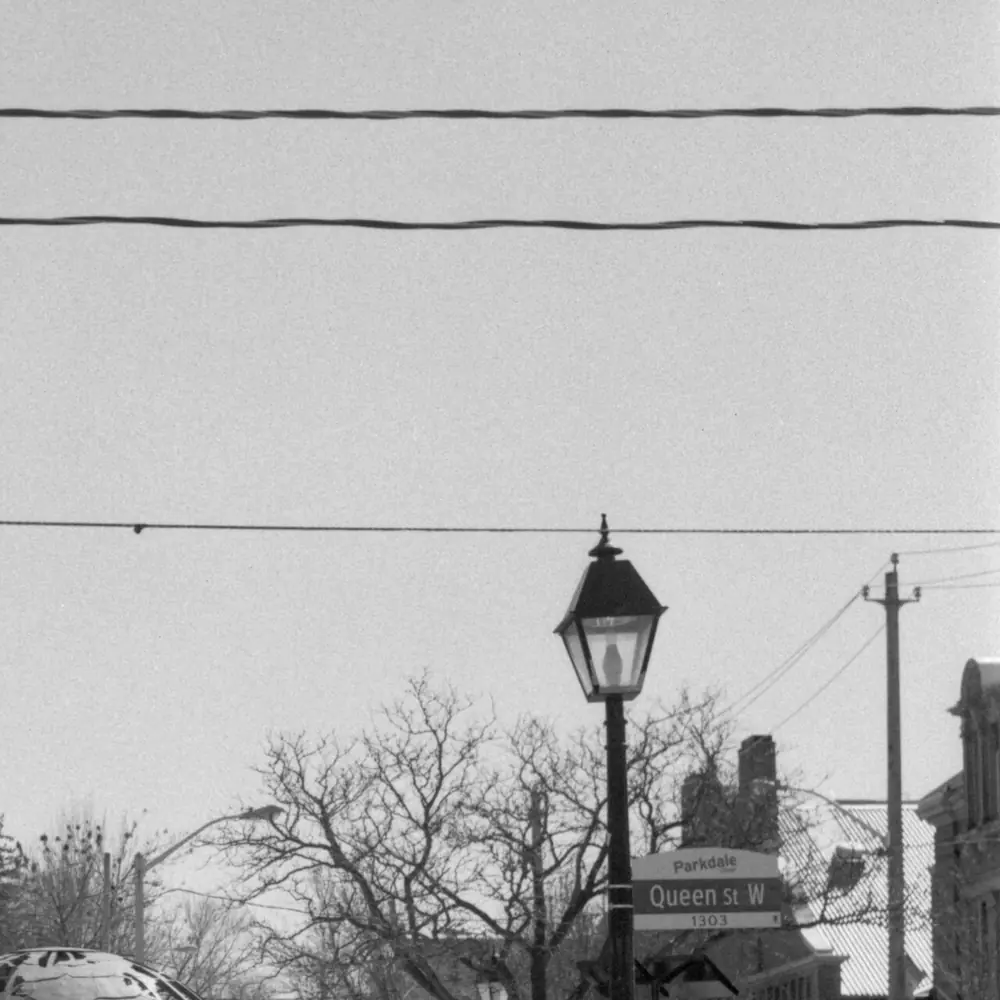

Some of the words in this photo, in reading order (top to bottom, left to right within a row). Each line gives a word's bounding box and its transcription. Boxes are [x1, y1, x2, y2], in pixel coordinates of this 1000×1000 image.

[673, 853, 737, 874] Parkdale
[650, 884, 717, 909] Queen
[723, 887, 739, 906] St
[747, 883, 765, 905] W
[691, 914, 728, 927] 1303
